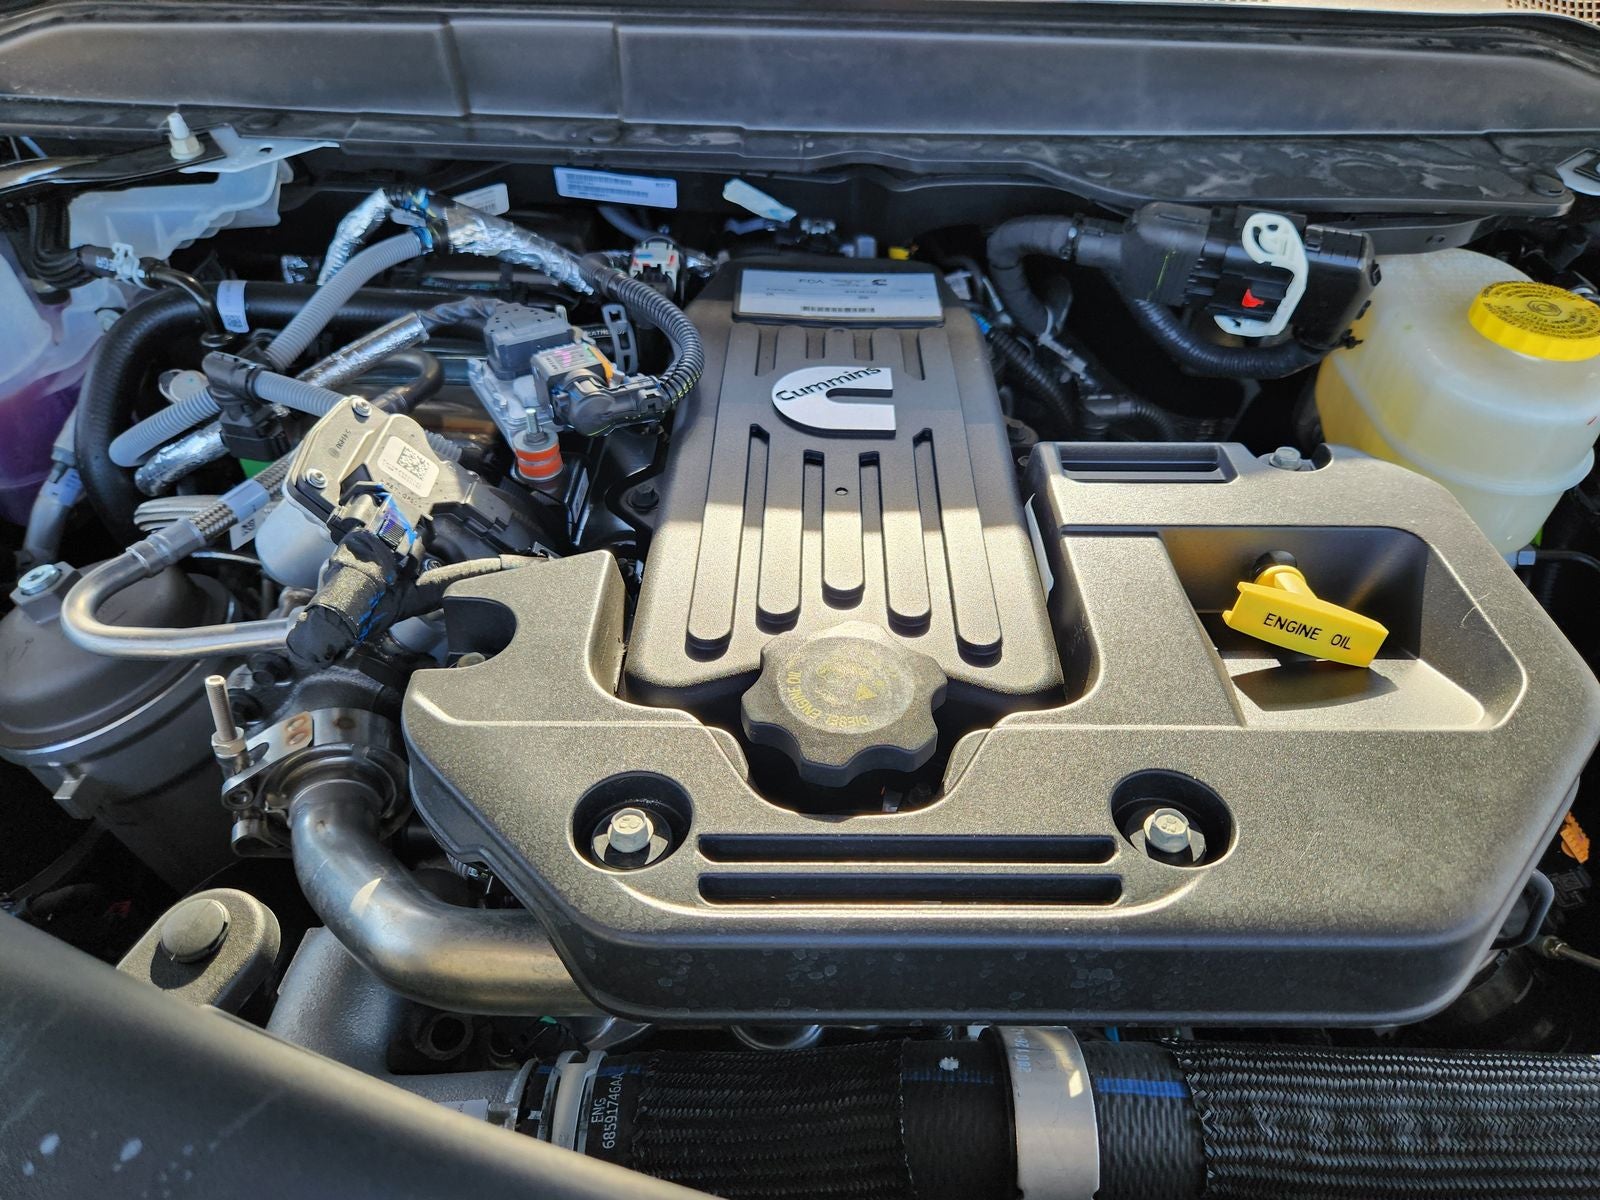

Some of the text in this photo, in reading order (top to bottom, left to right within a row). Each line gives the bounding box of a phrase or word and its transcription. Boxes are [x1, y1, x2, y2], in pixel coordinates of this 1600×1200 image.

[775, 367, 882, 401] Cummins
[1263, 612, 1351, 650] ENGINE OIL
[787, 684, 821, 719] ENGINE
[825, 715, 870, 727] DIESEL
[591, 1097, 607, 1124] ENG
[602, 1071, 625, 1150] 68591746AA
